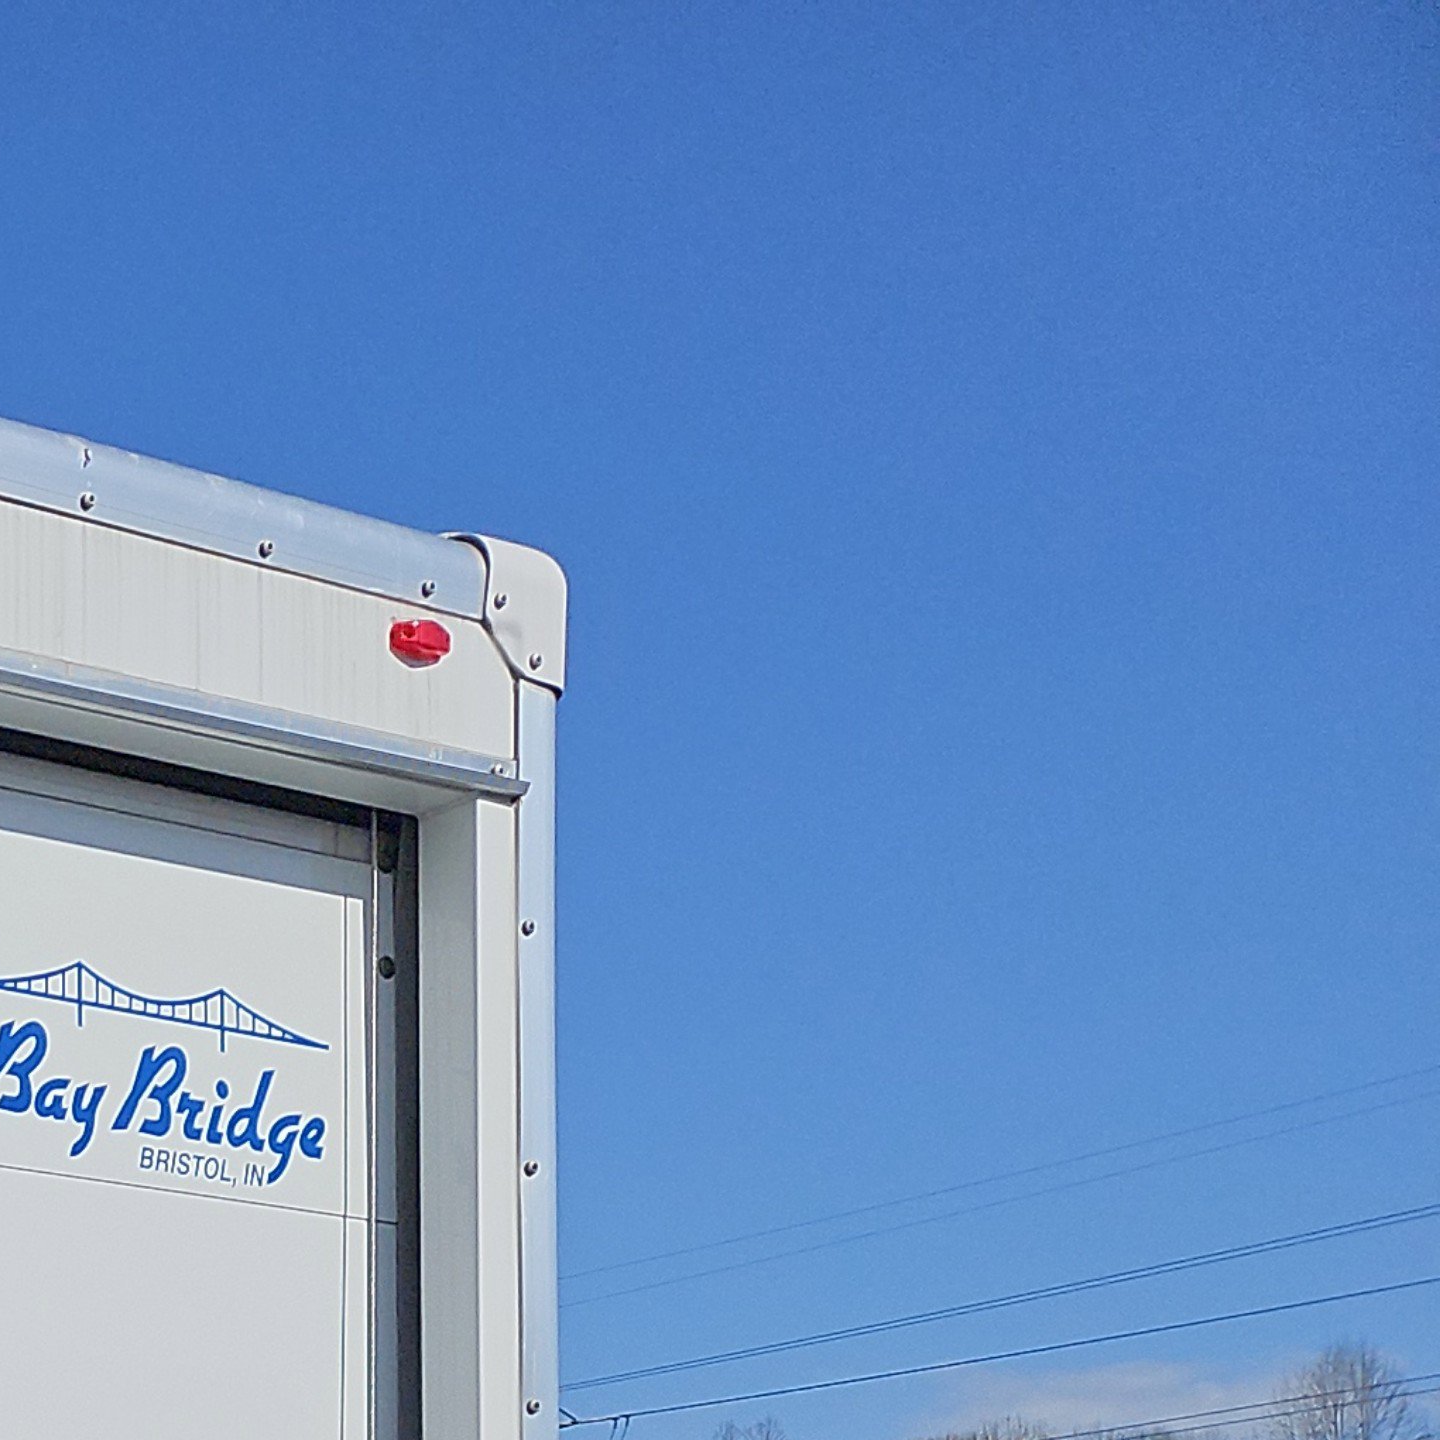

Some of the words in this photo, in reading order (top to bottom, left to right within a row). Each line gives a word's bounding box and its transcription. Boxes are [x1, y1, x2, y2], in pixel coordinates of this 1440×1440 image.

[111, 1046, 327, 1184] Bridge
[139, 1147, 238, 1186] BRISTOL,
[243, 1163, 266, 1187] IN
